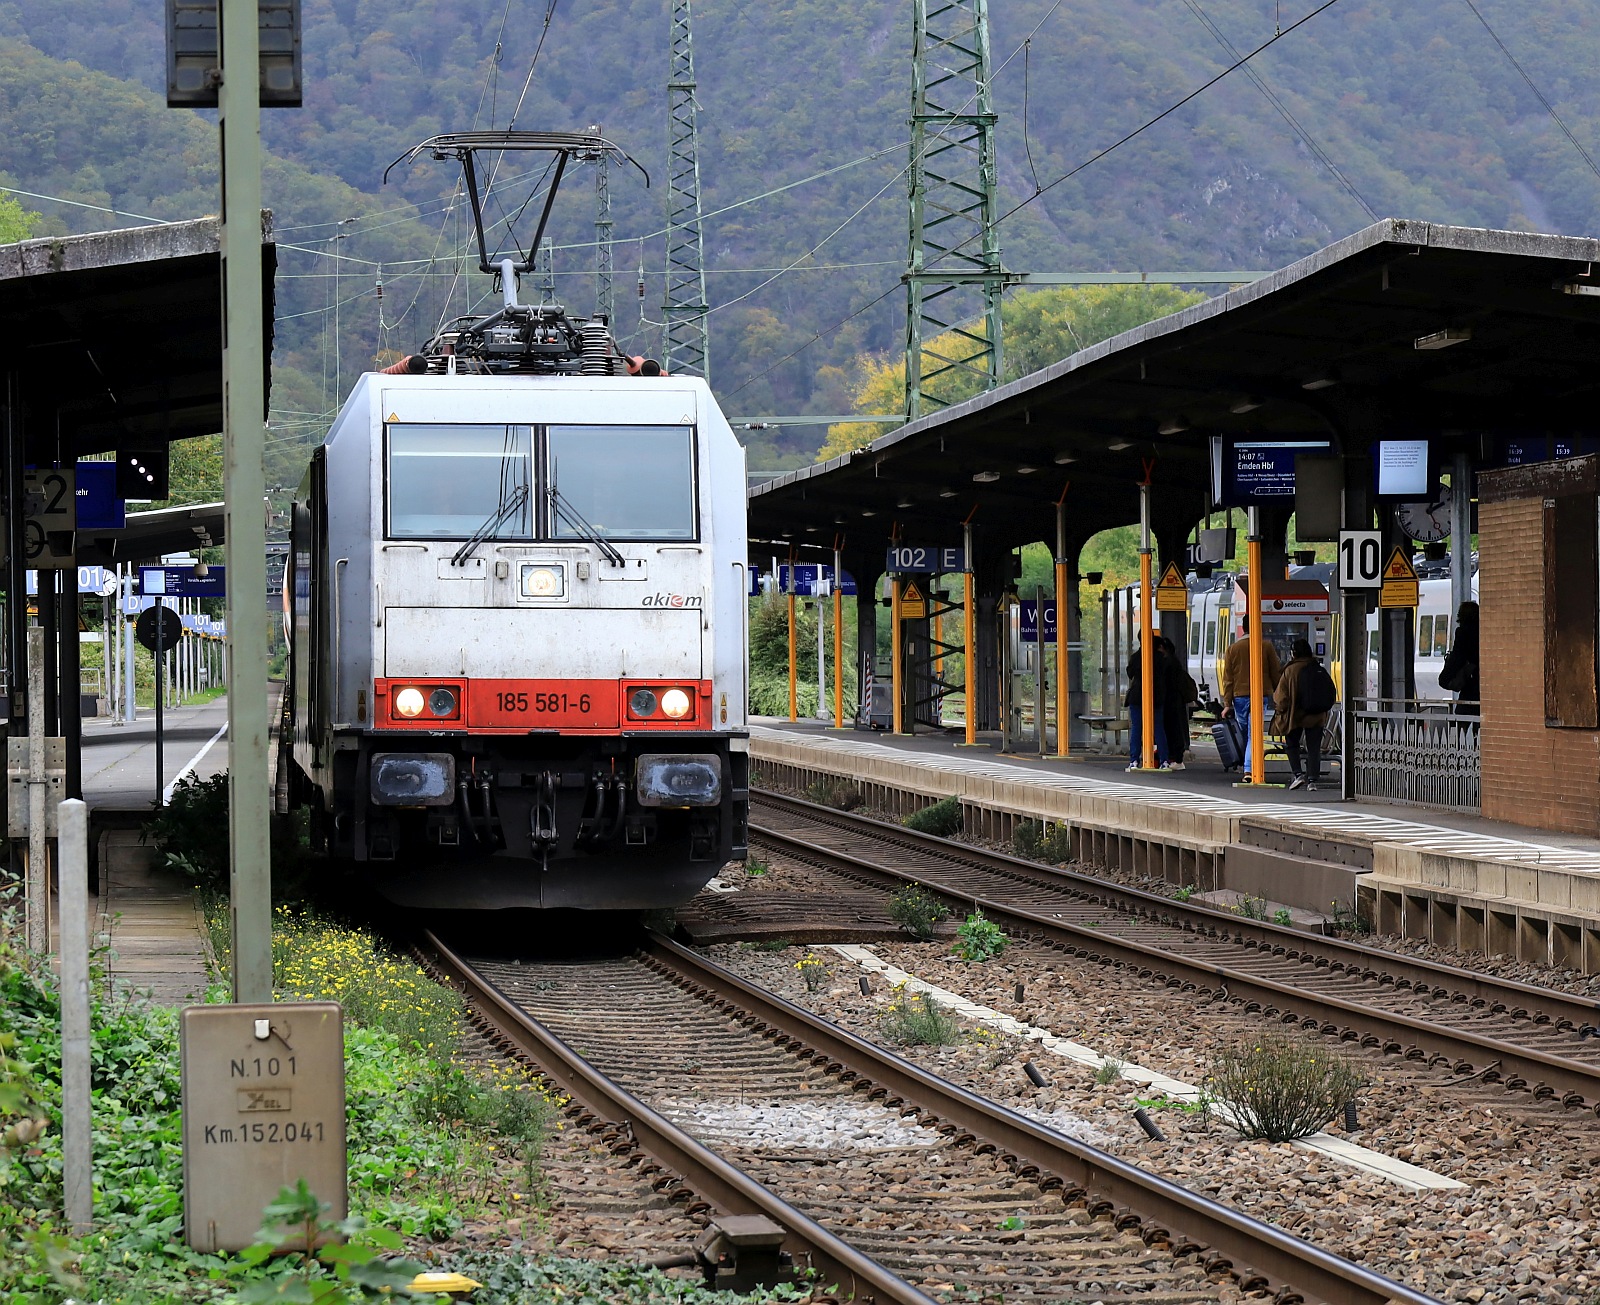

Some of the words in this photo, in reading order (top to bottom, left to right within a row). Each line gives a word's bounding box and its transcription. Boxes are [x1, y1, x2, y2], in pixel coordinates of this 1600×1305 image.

[1238, 453, 1256, 461] 14:07
[1237, 462, 1261, 470] Emden
[1261, 461, 1274, 470] Hbf
[891, 547, 926, 568] 102
[943, 548, 956, 568] E
[1341, 537, 1380, 581] 10
[128, 596, 138, 610] D
[641, 592, 702, 607] akiem
[193, 615, 209, 626] 101
[1027, 608, 1055, 623] WC
[211, 622, 224, 631] 101
[496, 692, 528, 712] 185
[535, 693, 591, 713] 581-6
[231, 1056, 297, 1078] N.101
[205, 1122, 325, 1144] Km.152.041
